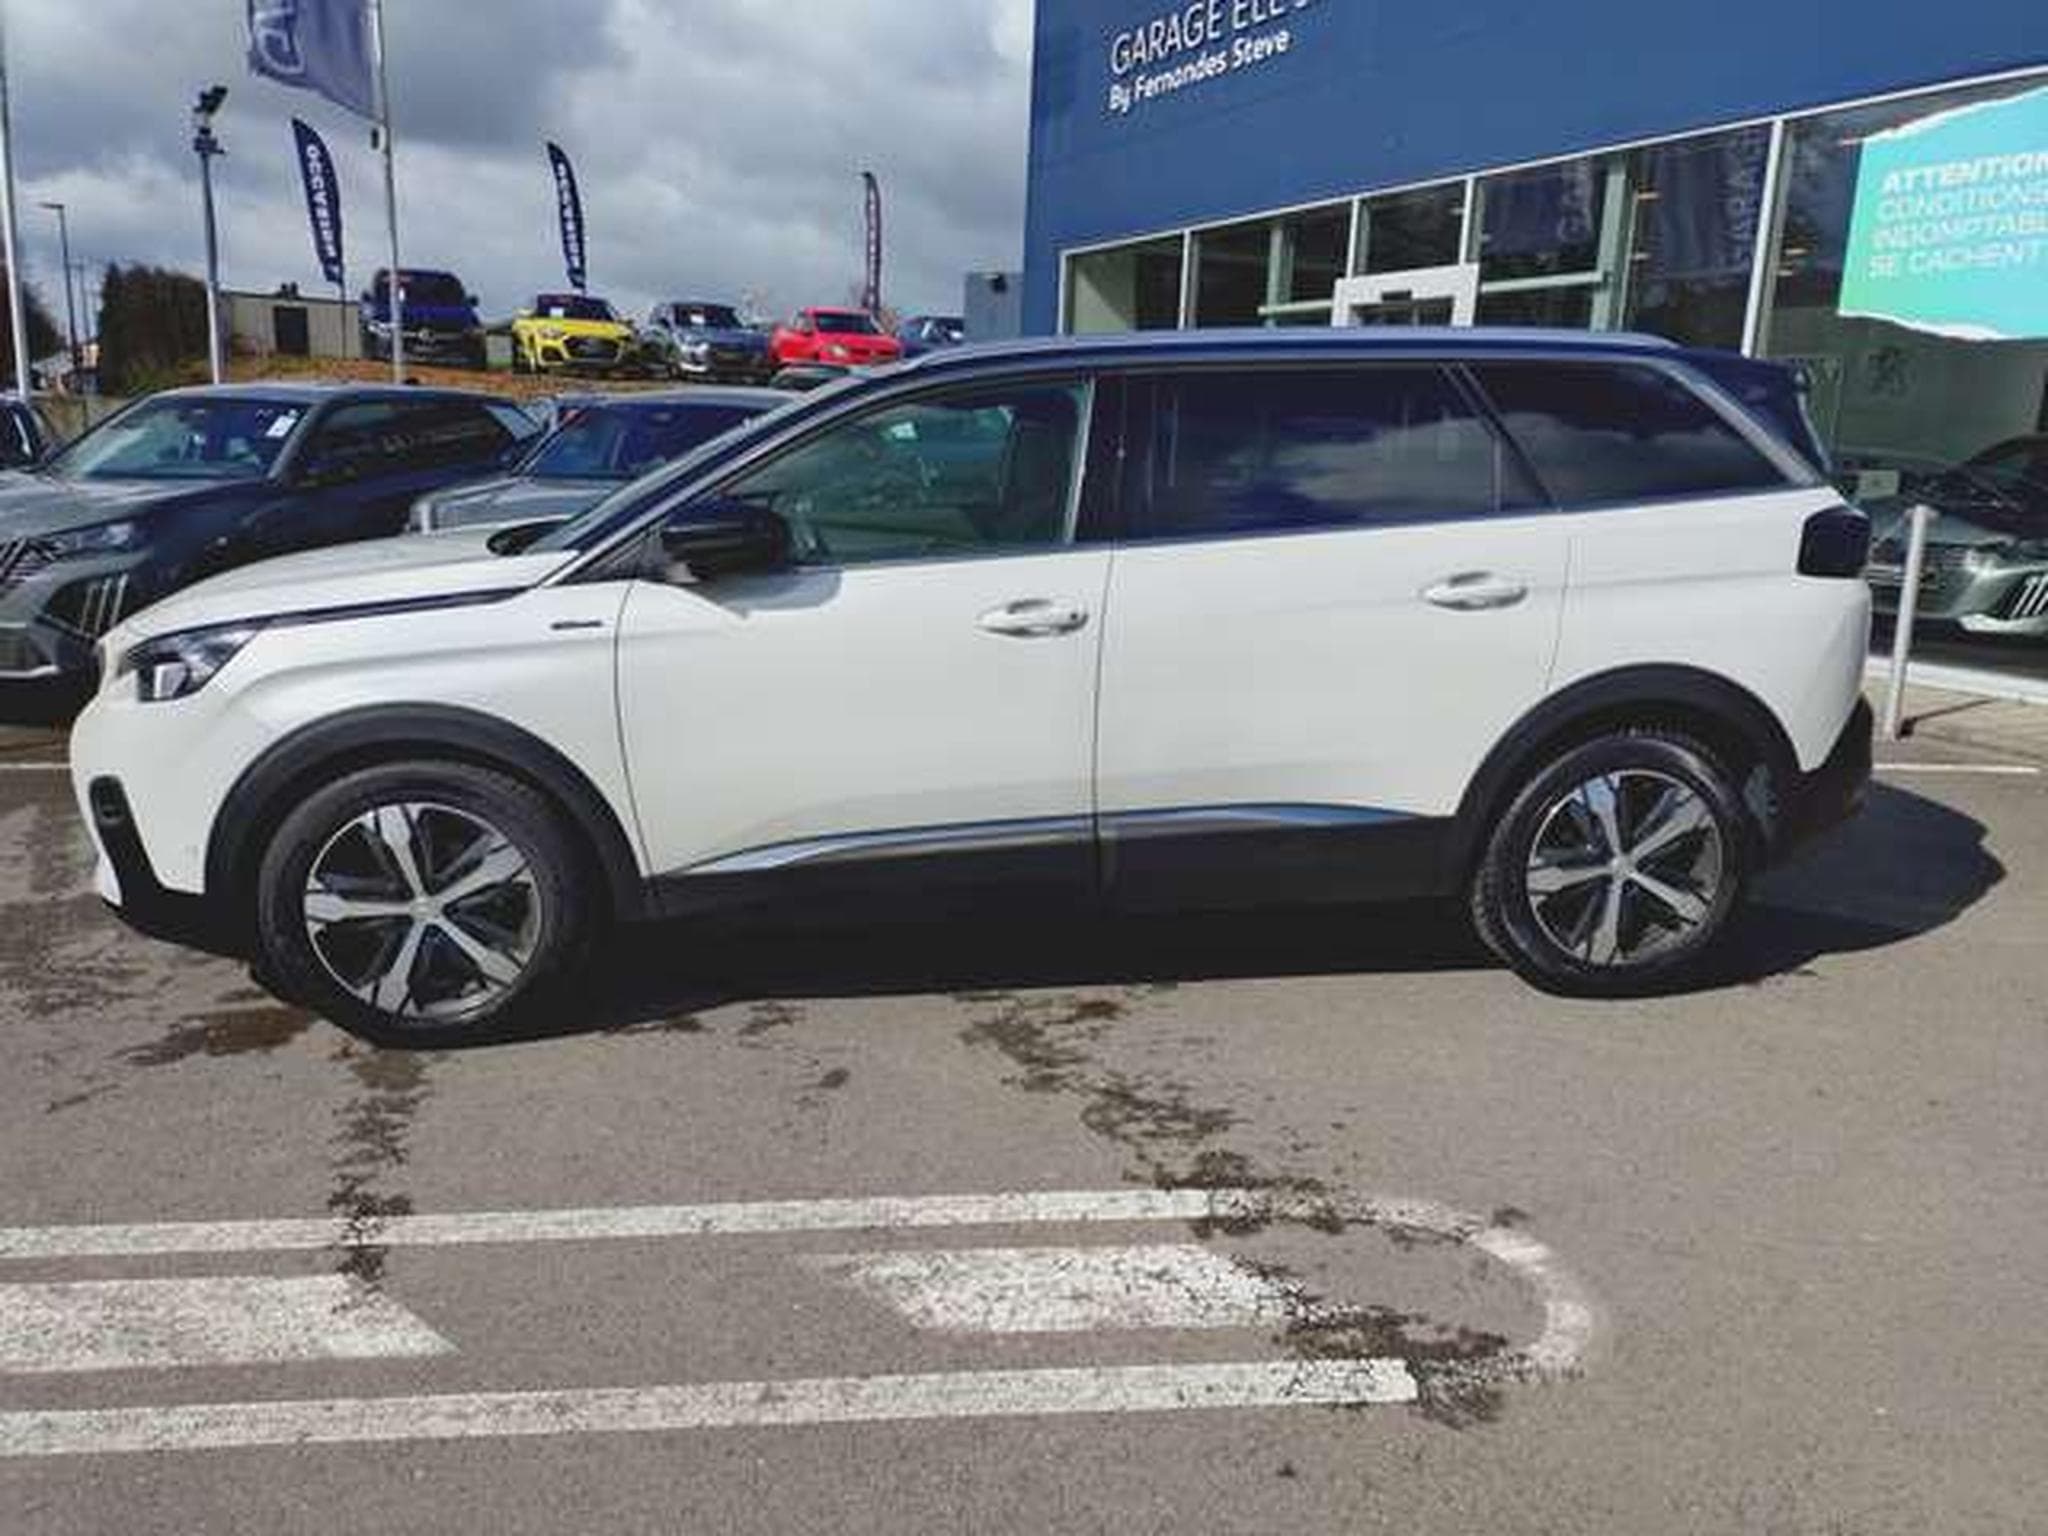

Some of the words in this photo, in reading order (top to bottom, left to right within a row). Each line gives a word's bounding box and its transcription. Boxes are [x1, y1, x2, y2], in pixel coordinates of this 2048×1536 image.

[1109, 84, 1130, 113] By
[1134, 52, 1228, 101] Fernandes
[1231, 30, 1290, 68] Steve
[1111, 0, 1222, 75] GARAGE
